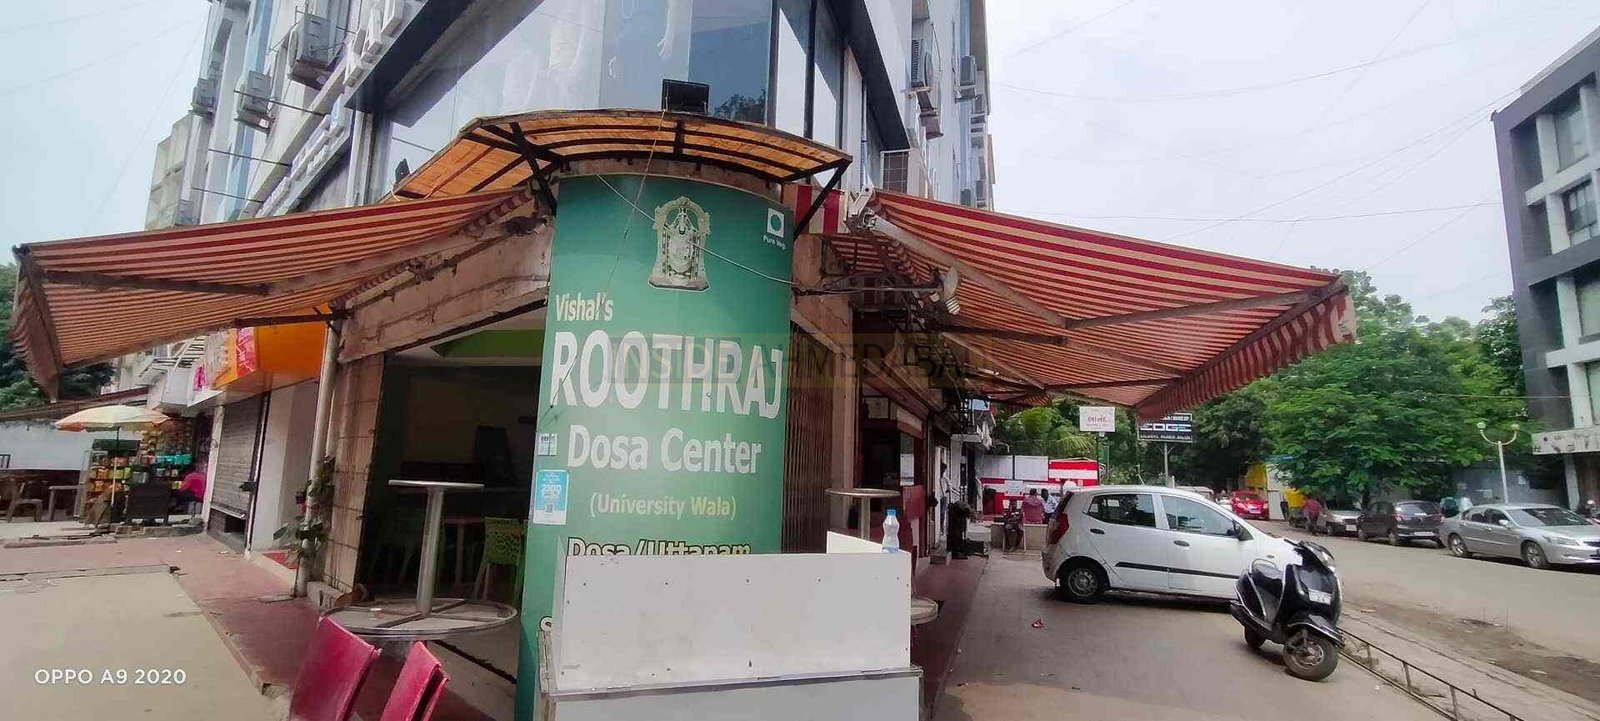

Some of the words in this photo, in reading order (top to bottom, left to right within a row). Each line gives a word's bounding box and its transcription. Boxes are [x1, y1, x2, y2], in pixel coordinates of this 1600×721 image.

[556, 293, 614, 321] Vishal's
[552, 329, 783, 419] ROOTHRAJ
[567, 424, 648, 470] Dosa
[660, 428, 762, 474] Center
[590, 493, 684, 520] (University
[691, 496, 736, 520] Wala)
